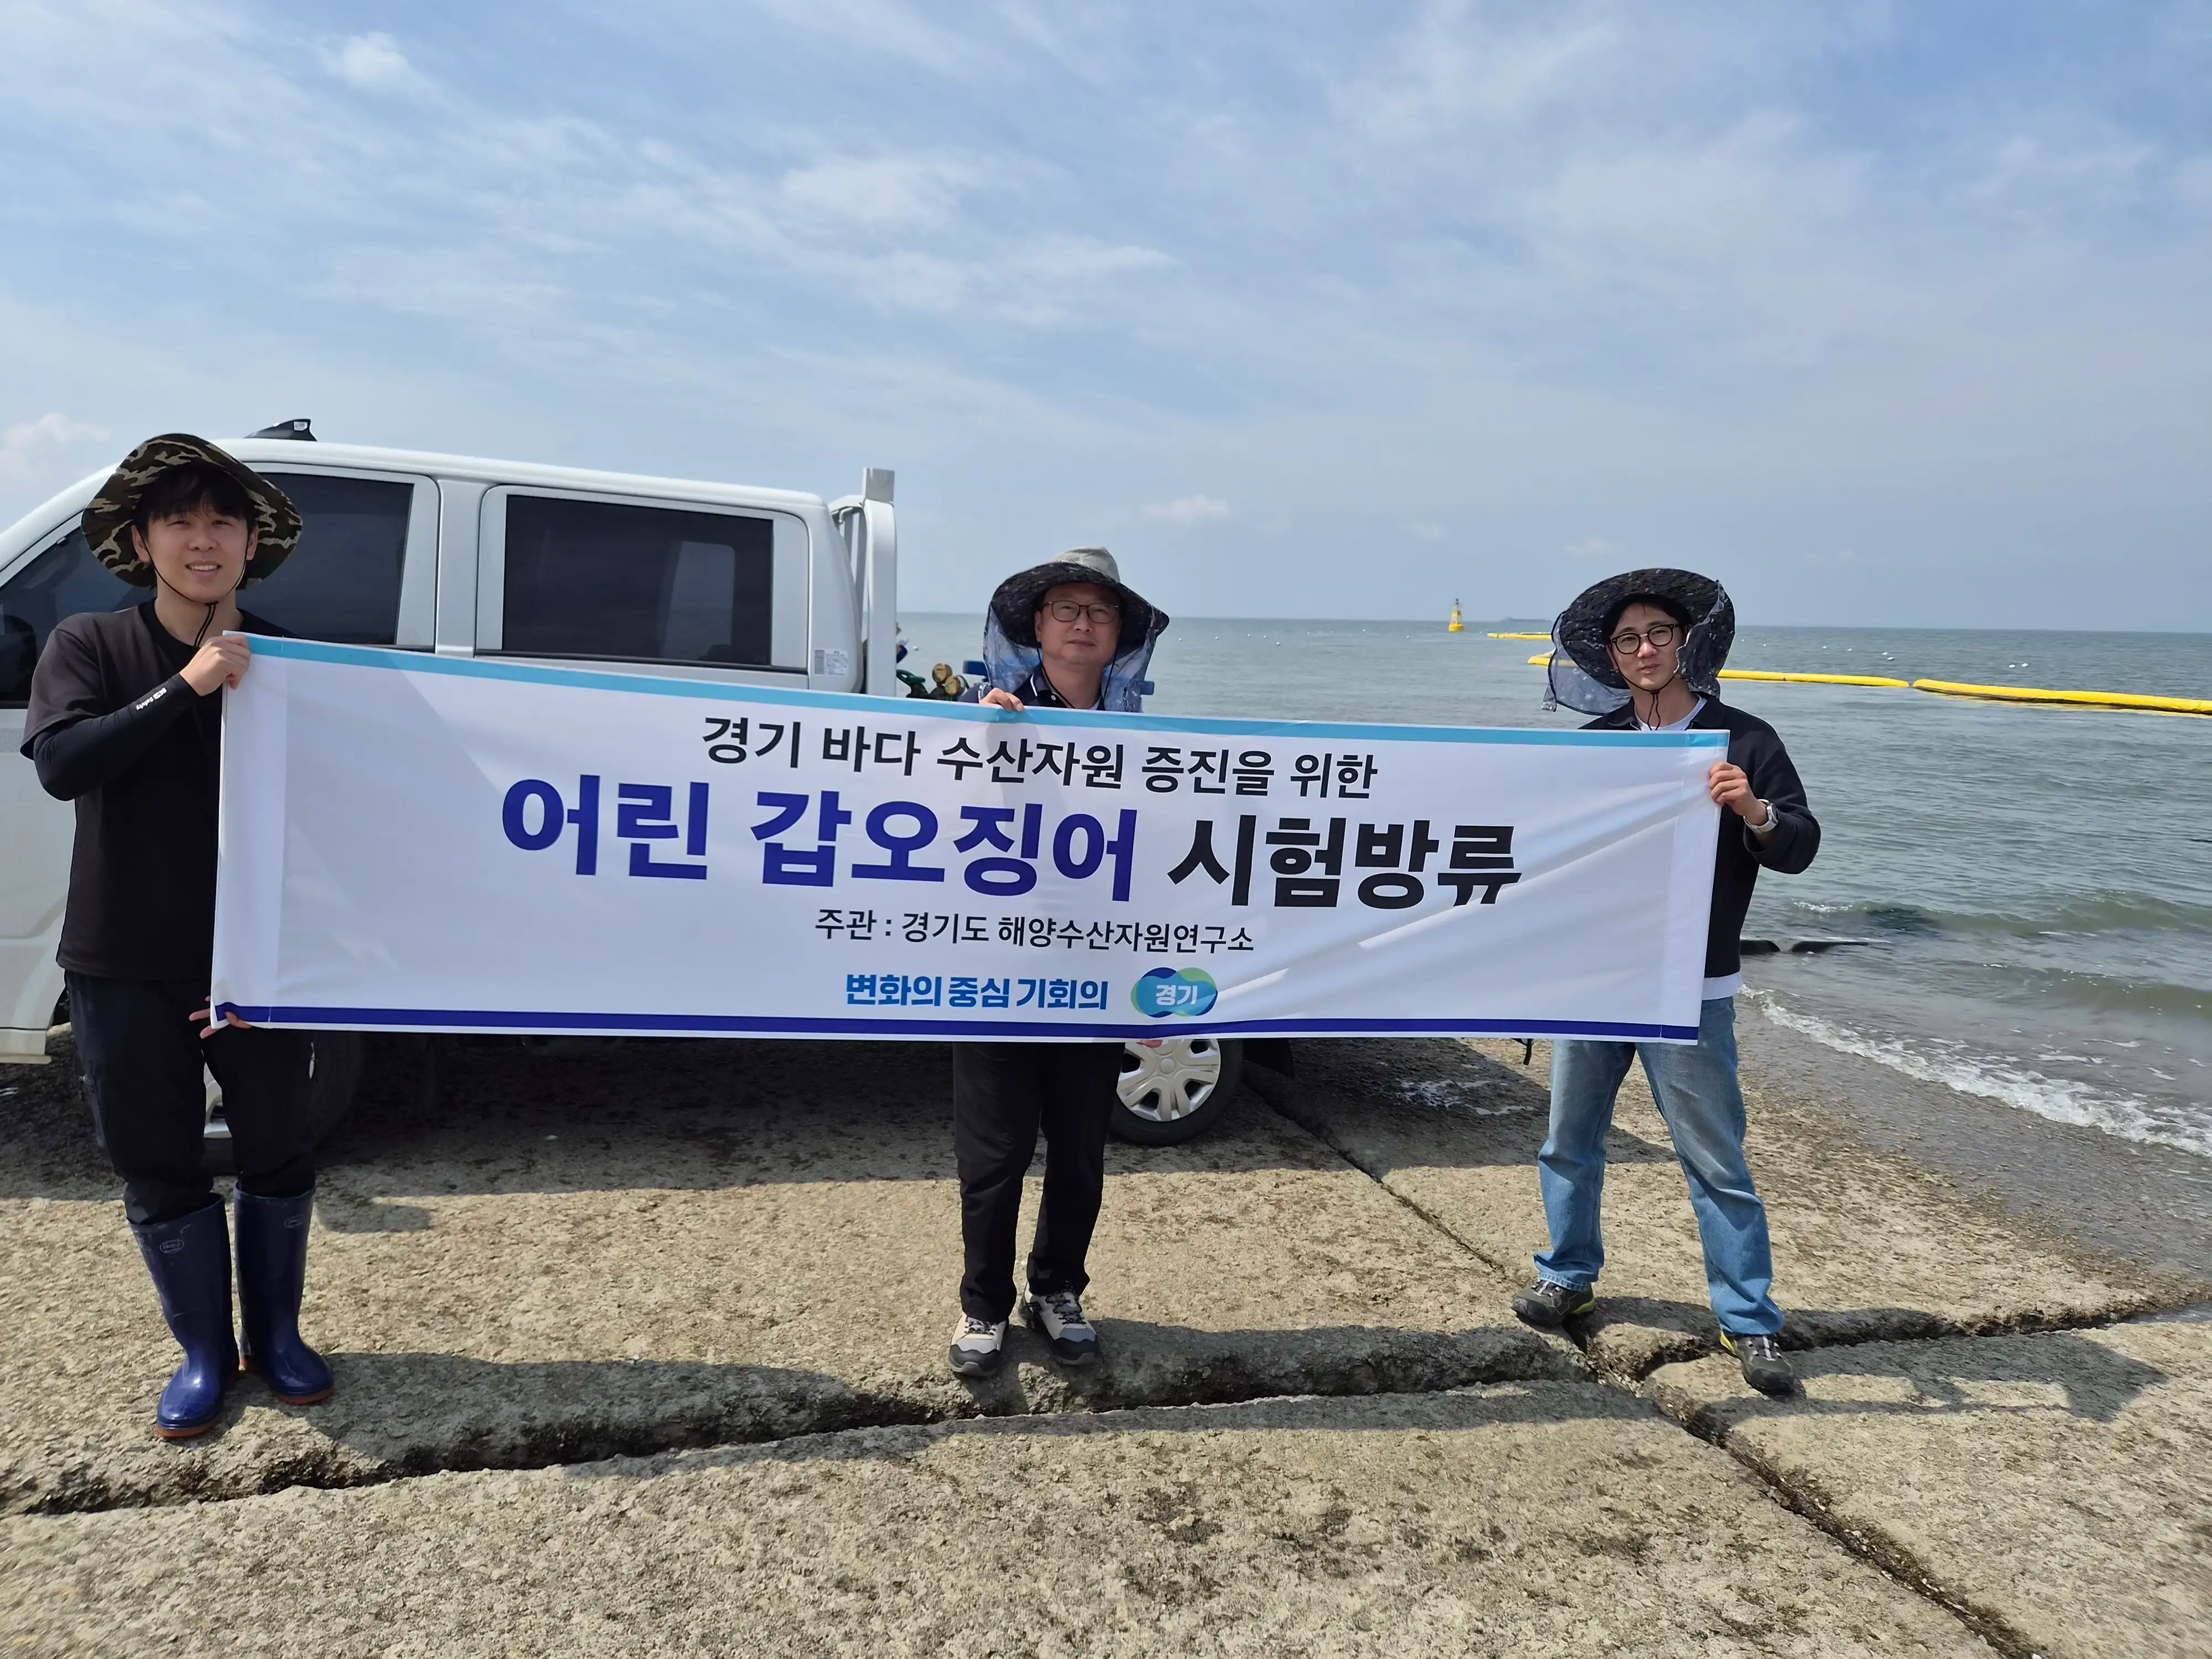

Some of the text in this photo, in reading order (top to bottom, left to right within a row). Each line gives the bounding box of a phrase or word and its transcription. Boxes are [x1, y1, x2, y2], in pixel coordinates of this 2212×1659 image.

[703, 717, 1378, 799] 경기 바다 수산자원 증진을 위한
[502, 774, 1522, 909] 어린 갑오징어 시험방류
[815, 909, 1254, 953] 주관 : 경기도 해양수산자원연구소
[846, 974, 1199, 1010] 변화의 중심 기회의 경기
